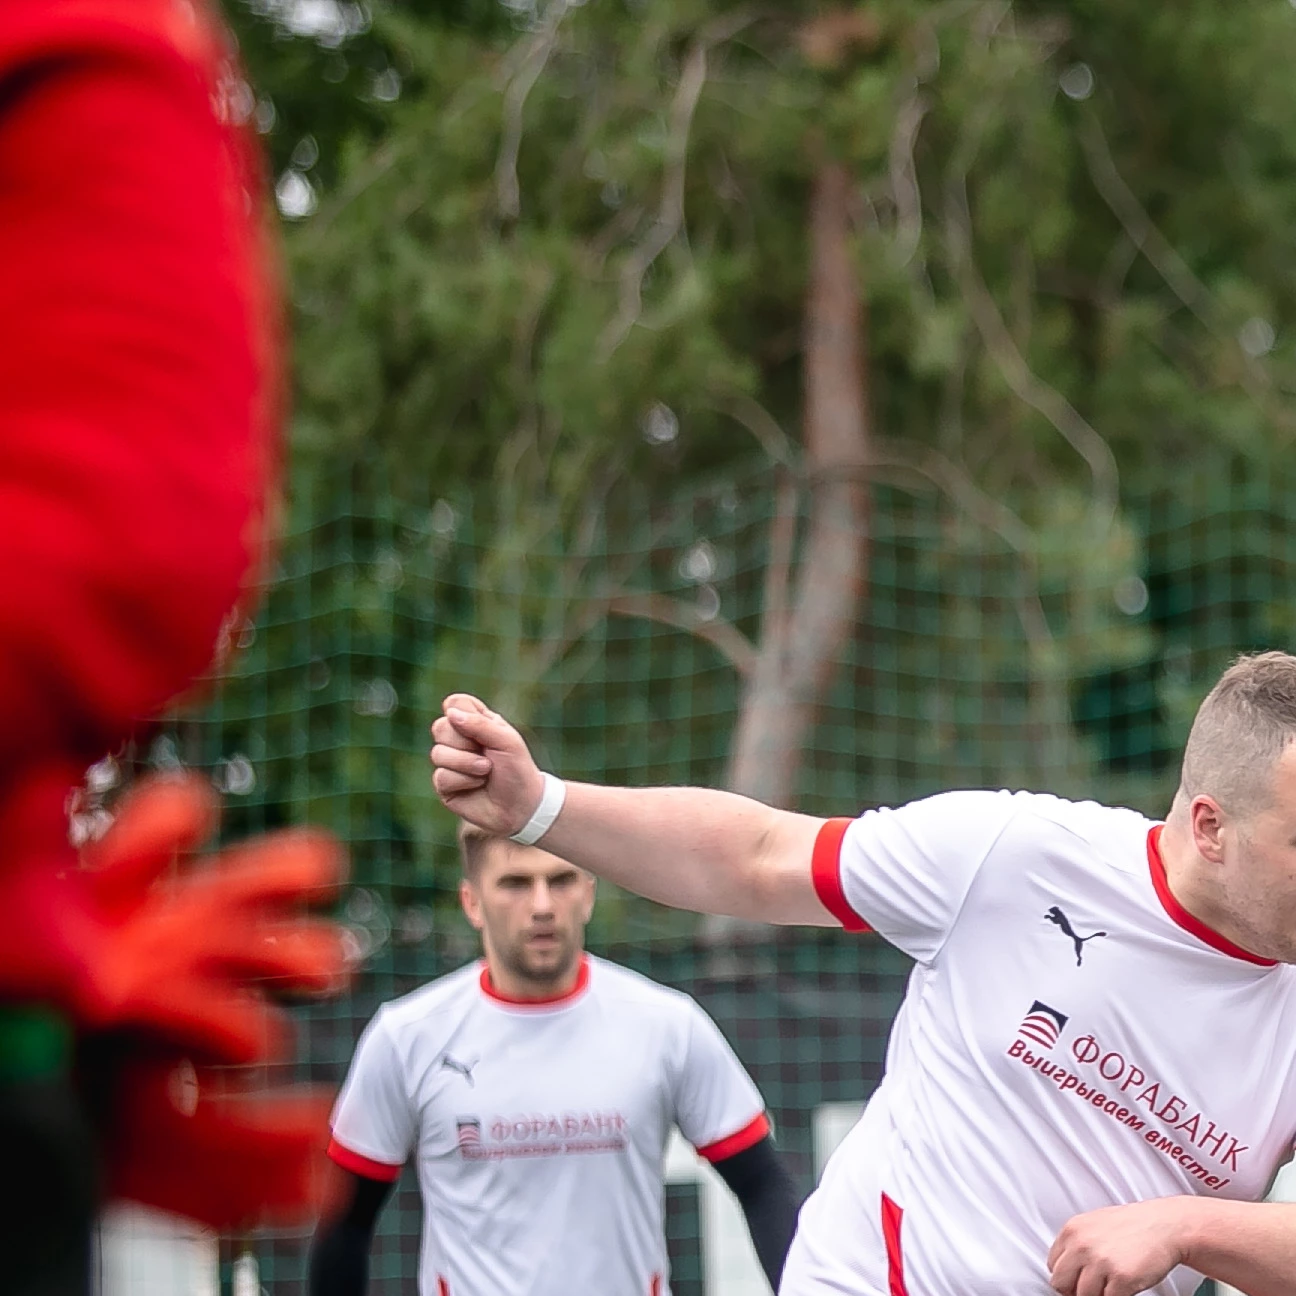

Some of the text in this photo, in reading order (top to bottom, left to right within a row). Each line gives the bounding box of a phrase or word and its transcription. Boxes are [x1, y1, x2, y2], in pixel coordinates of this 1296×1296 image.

[1007, 1039, 1231, 1191] Выигрываем вместе!
[1071, 1035, 1249, 1172] ФОРАБАНК
